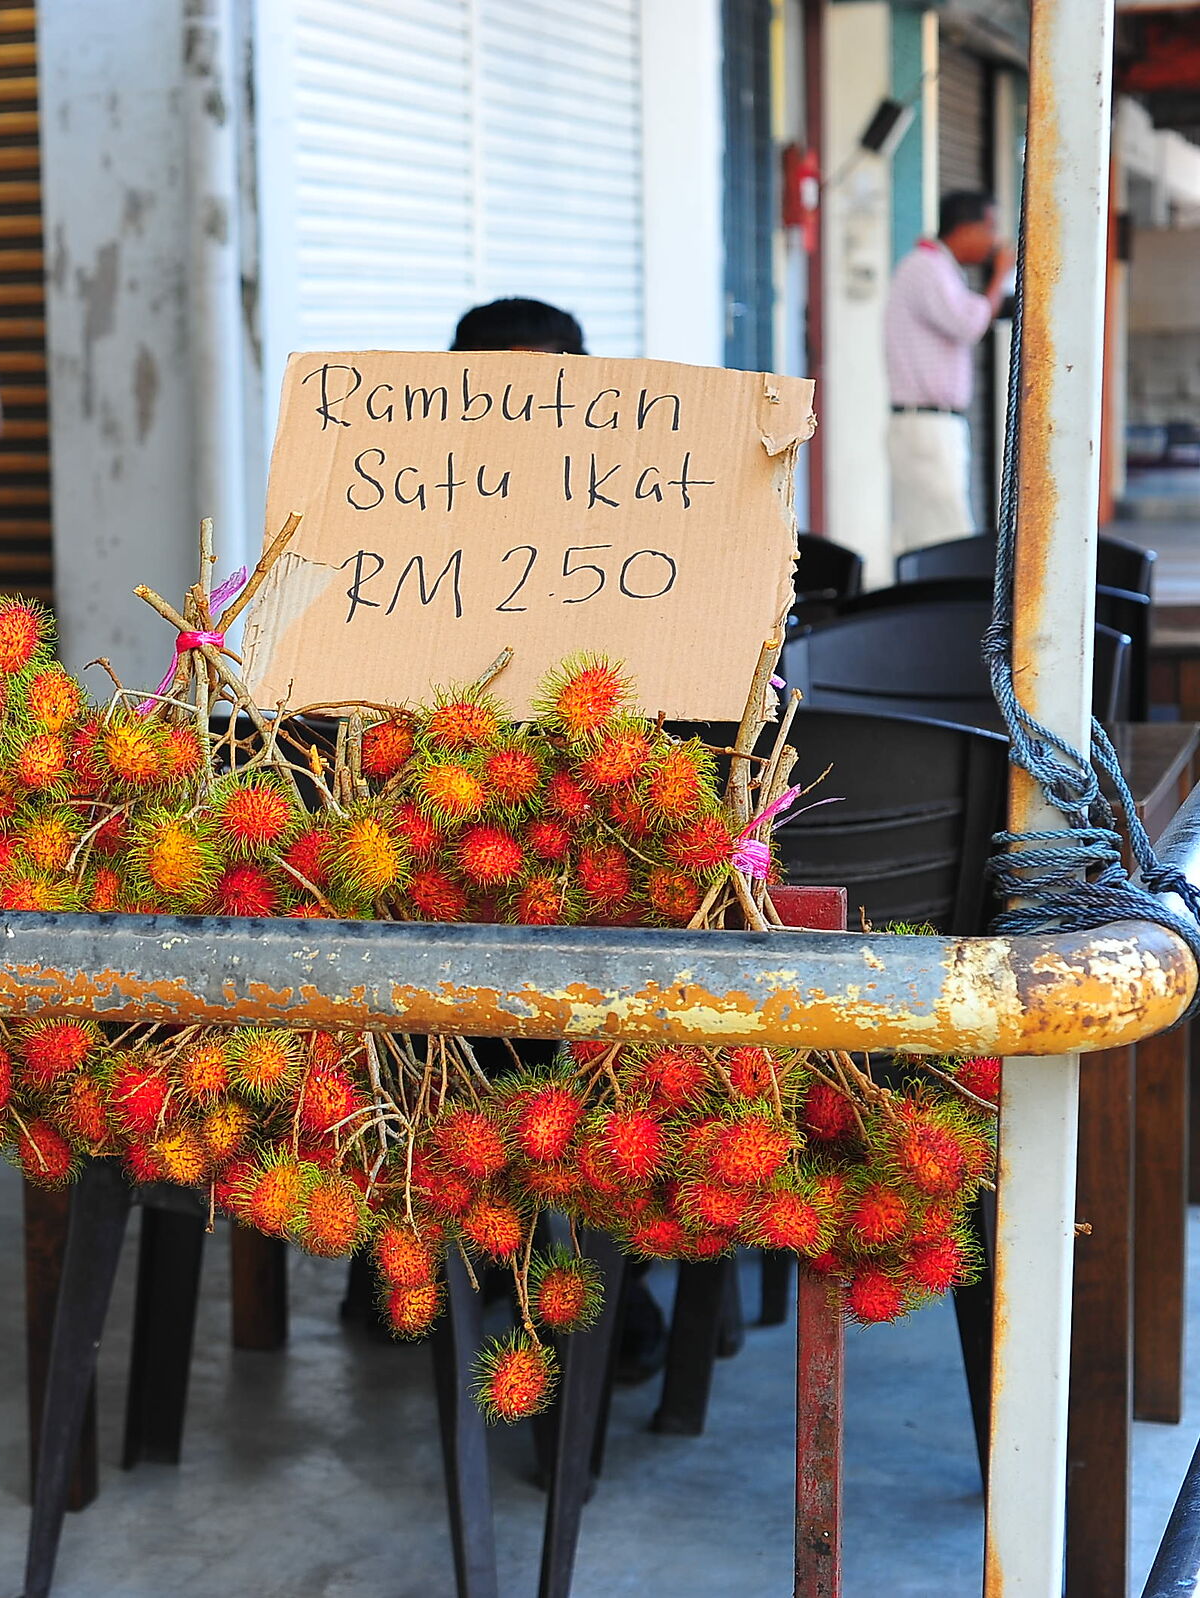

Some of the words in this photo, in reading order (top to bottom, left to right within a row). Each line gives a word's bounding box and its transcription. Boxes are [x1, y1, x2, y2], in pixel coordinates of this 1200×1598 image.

[301, 363, 681, 431] Rambutan
[346, 448, 511, 512] Satu
[564, 451, 716, 510] Ikat
[340, 548, 463, 624] RM
[495, 544, 678, 612] 2.50
